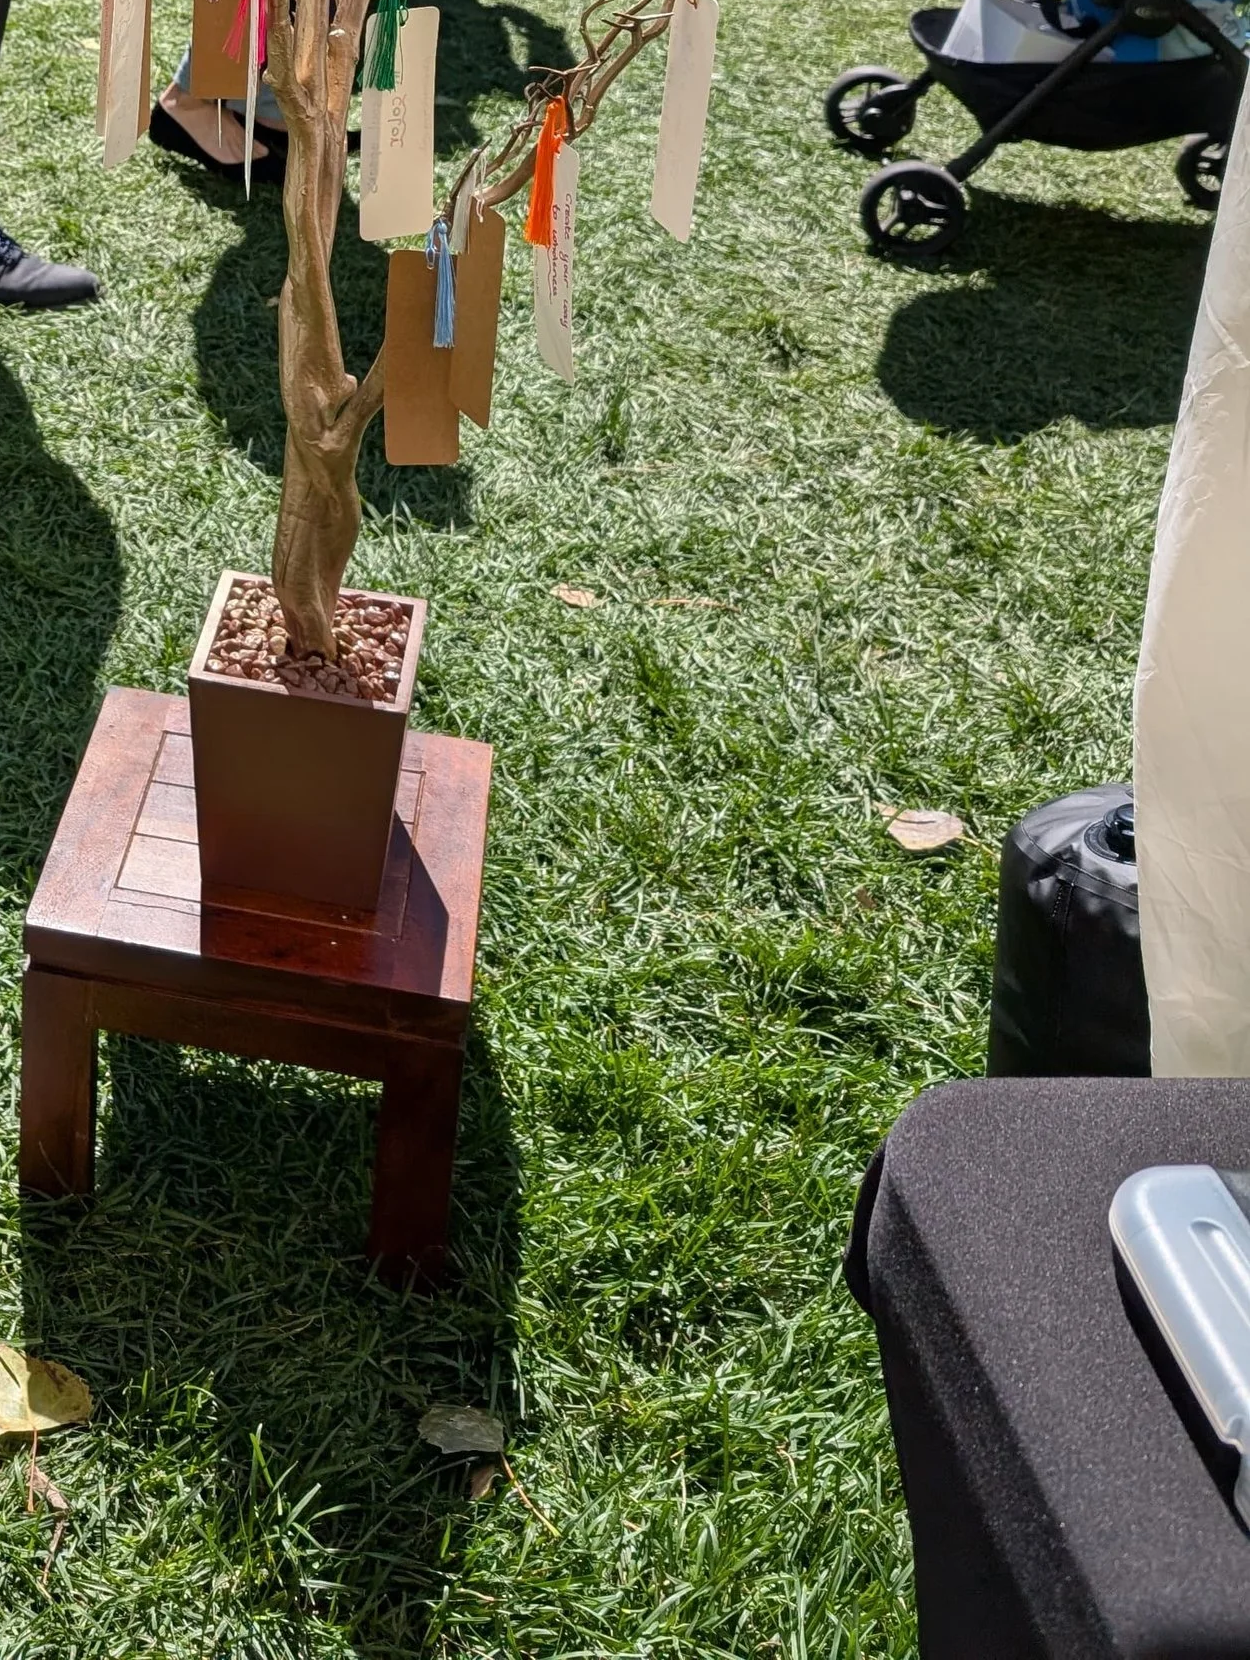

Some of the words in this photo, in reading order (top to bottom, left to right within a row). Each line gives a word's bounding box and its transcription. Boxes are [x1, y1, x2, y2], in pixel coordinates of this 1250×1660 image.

[552, 204, 561, 221] to
[563, 192, 573, 240] Create
[559, 251, 570, 289] your
[559, 299, 570, 329] way
